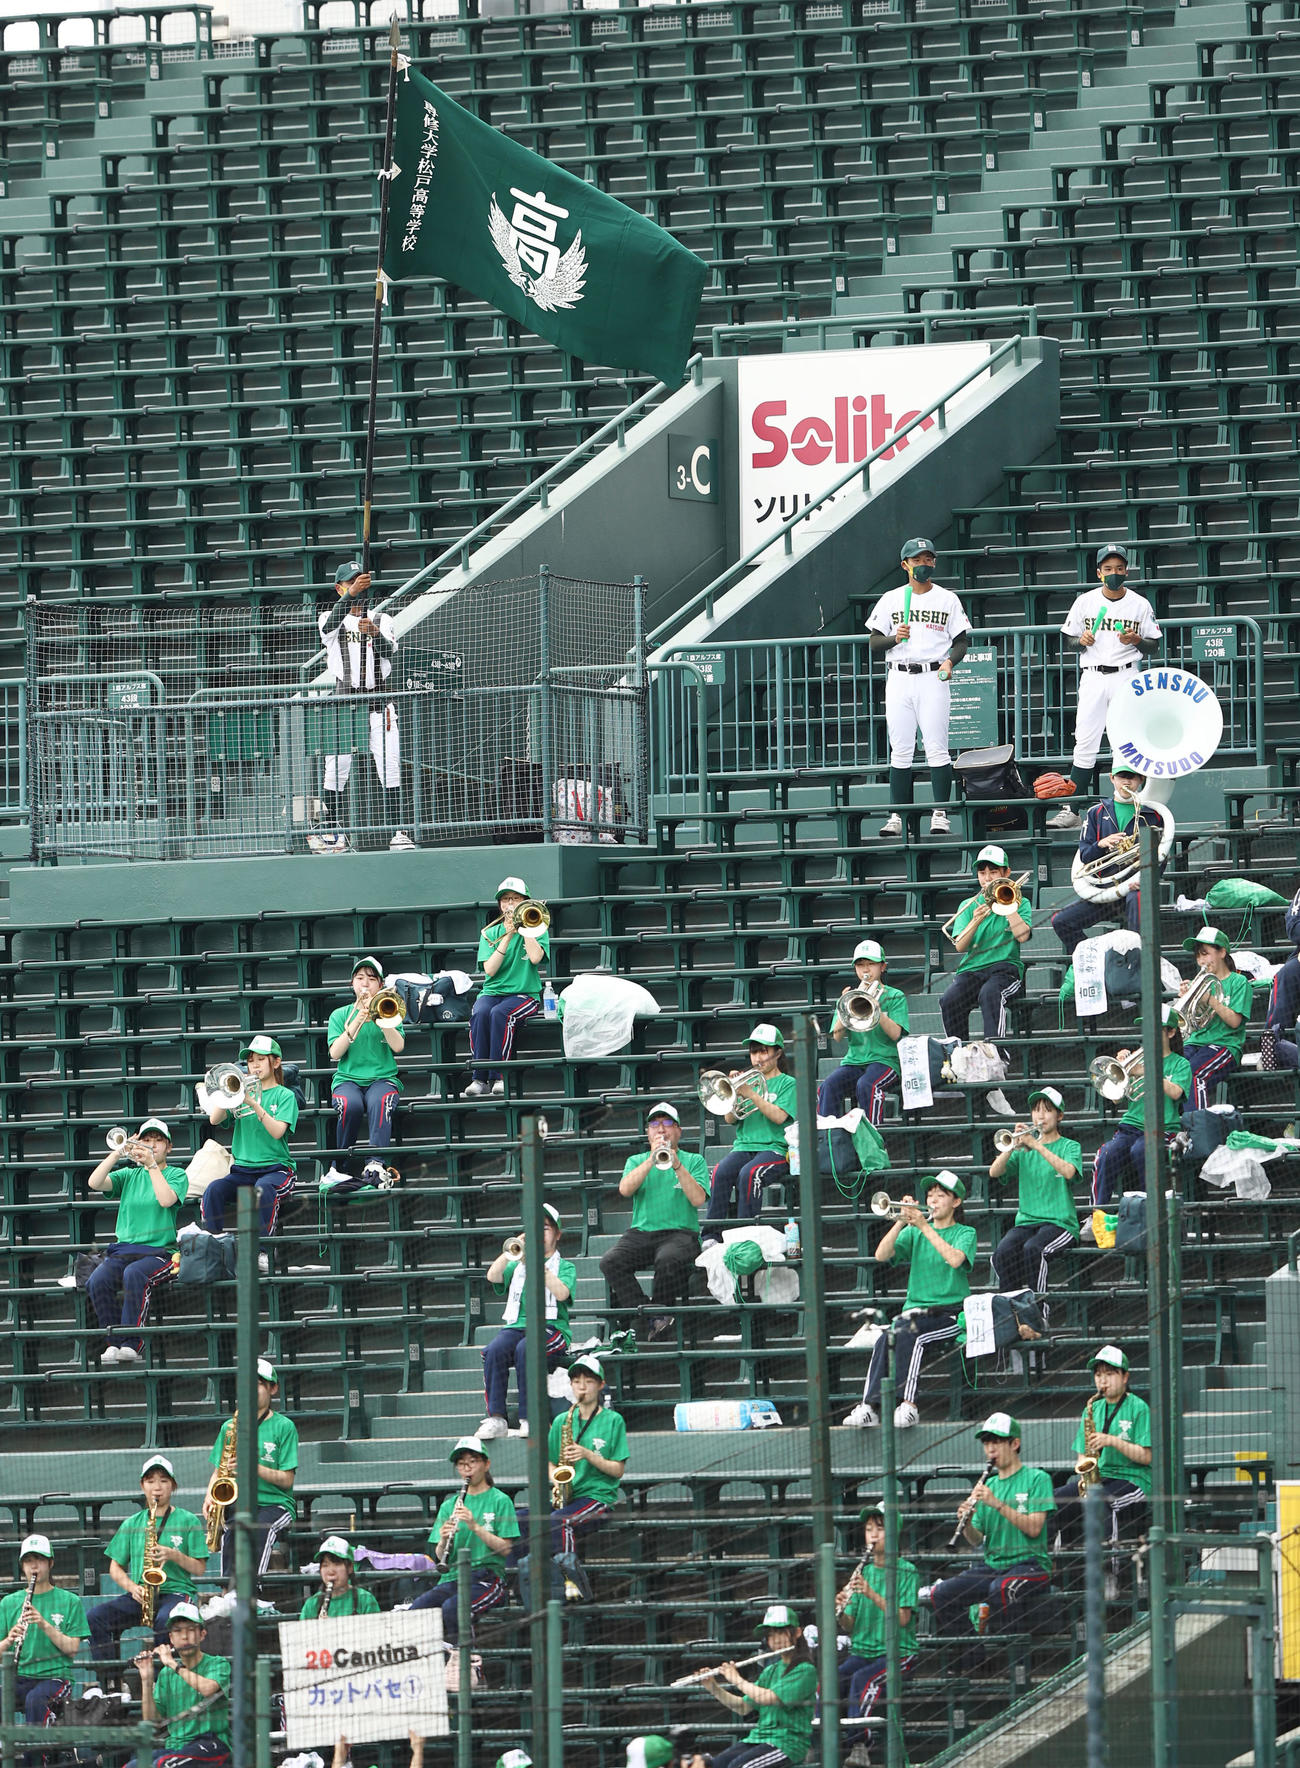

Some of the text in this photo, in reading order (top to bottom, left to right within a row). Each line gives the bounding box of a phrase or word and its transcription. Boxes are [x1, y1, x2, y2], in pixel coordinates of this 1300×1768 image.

[676, 444, 711, 495] 3-C
[1205, 638, 1224, 648] 43段
[1132, 671, 1210, 704] SENSHU
[1118, 741, 1204, 776] MATSUDO
